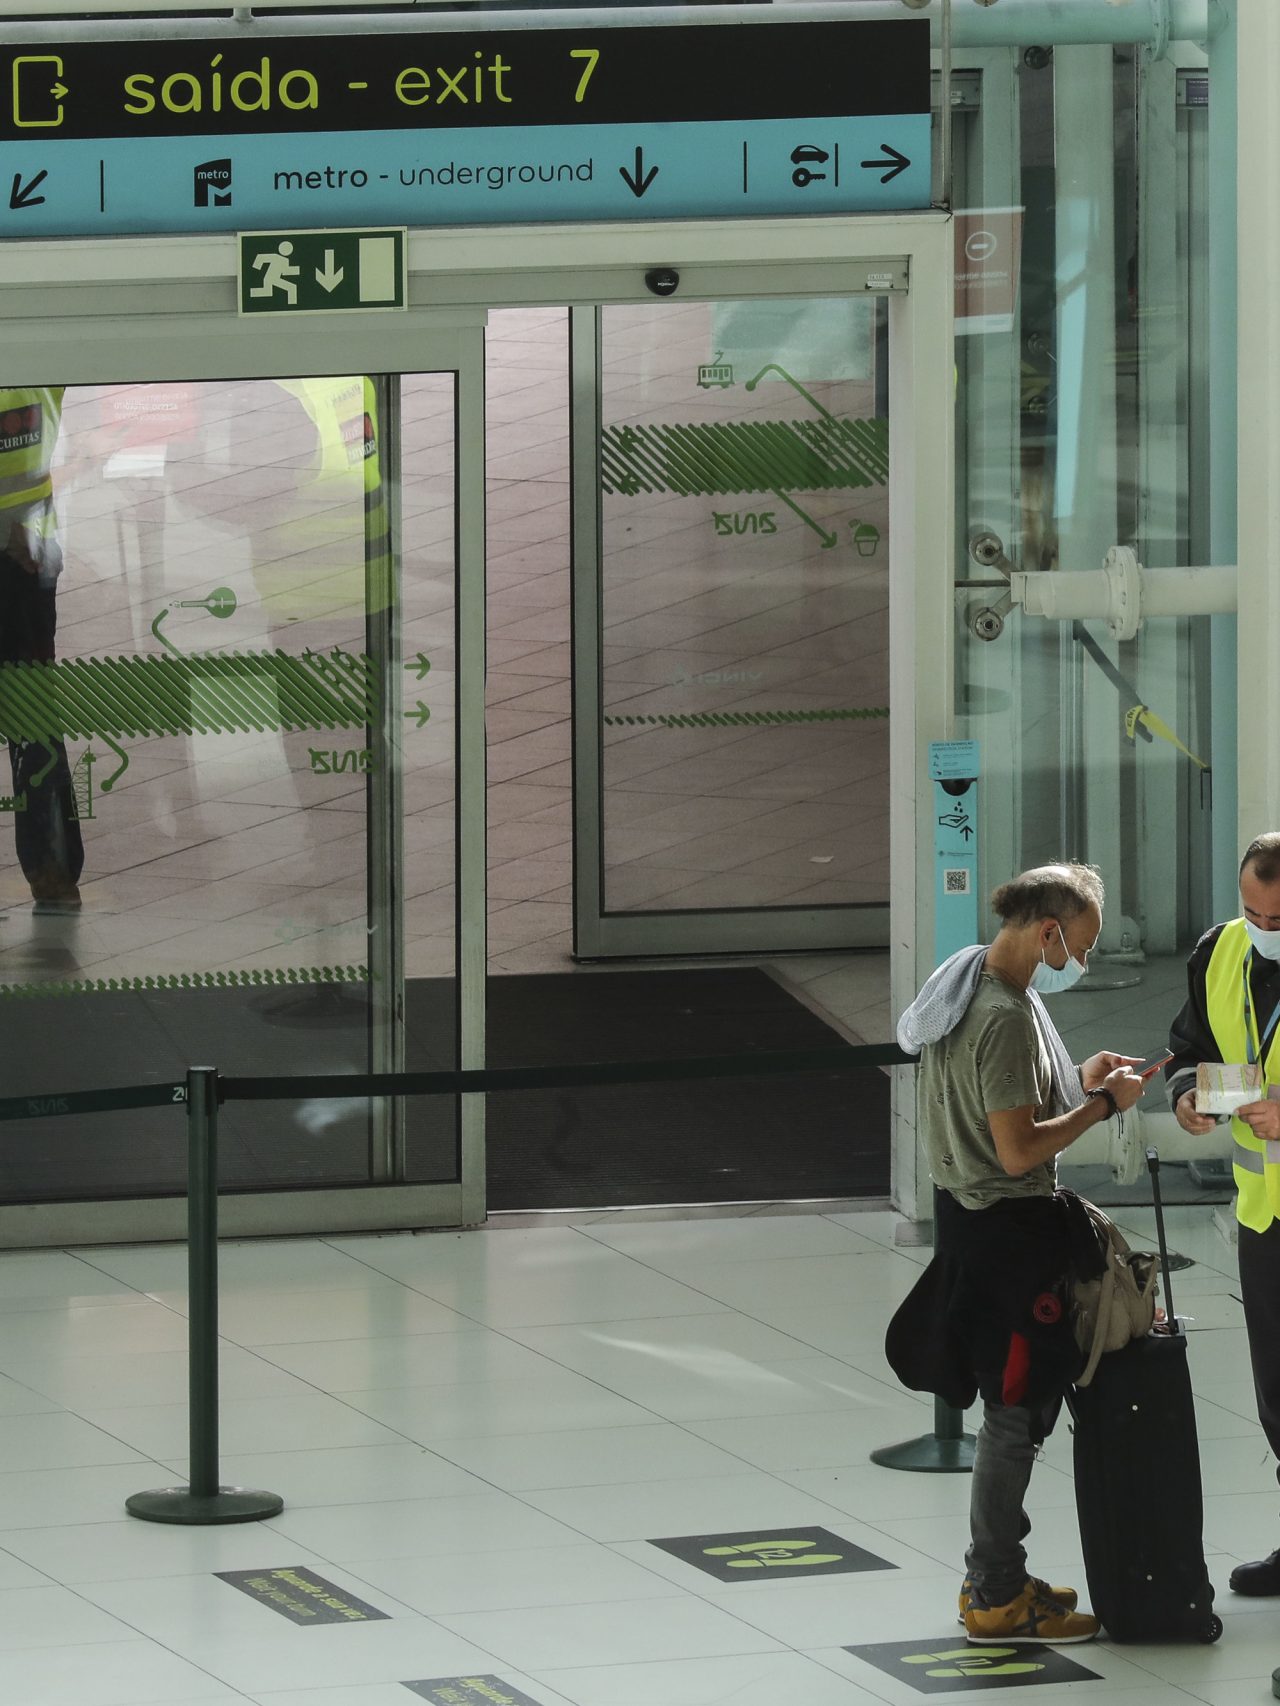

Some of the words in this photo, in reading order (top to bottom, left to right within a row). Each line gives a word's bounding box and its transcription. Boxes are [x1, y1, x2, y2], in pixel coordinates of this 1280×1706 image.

[124, 53, 318, 114] saída
[395, 51, 512, 105] exit
[570, 49, 599, 102] 7
[198, 169, 229, 179] metro
[274, 166, 368, 190] metro
[400, 158, 593, 190] underground
